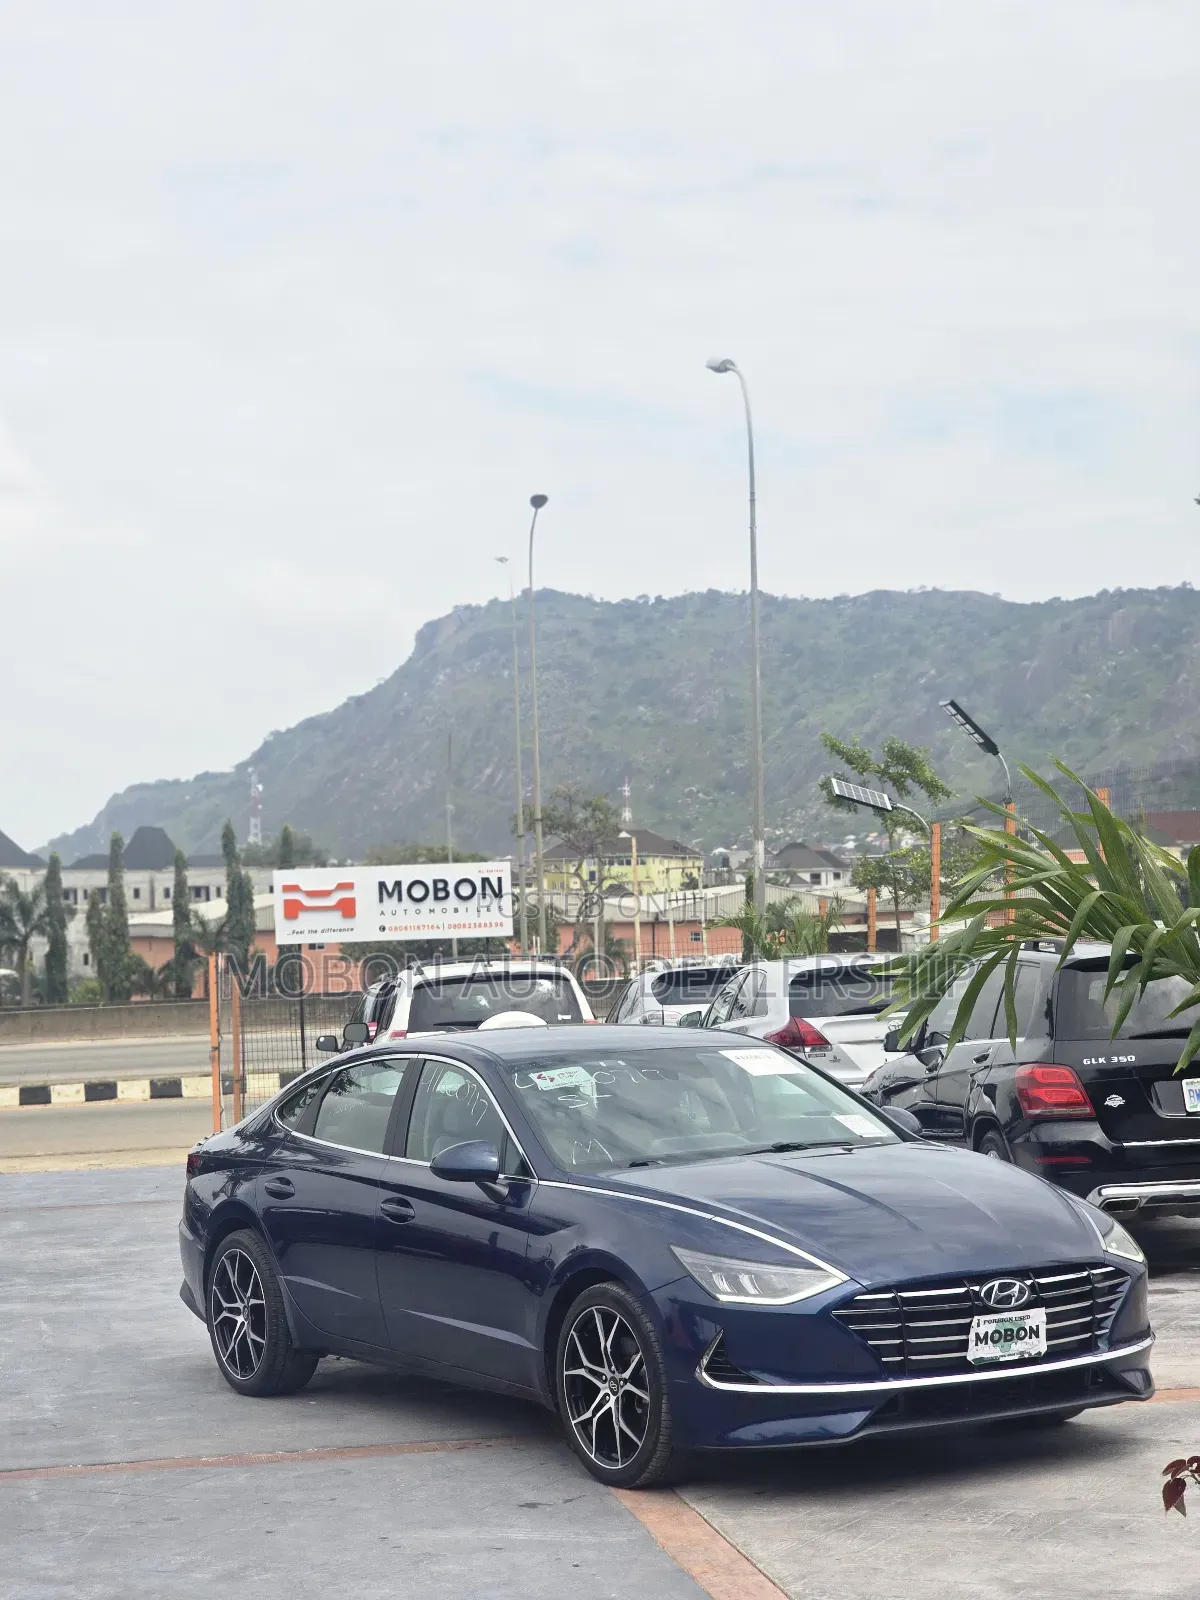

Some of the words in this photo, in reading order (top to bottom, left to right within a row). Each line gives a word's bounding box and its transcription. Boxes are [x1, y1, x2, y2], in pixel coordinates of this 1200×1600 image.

[378, 876, 503, 903] MOBON
[379, 906, 504, 916] AUTOMOBILES
[320, 926, 355, 934] difference
[1083, 1056, 1107, 1065] GLK
[1111, 1055, 1136, 1063] 350
[975, 1325, 1040, 1347] MOBON
